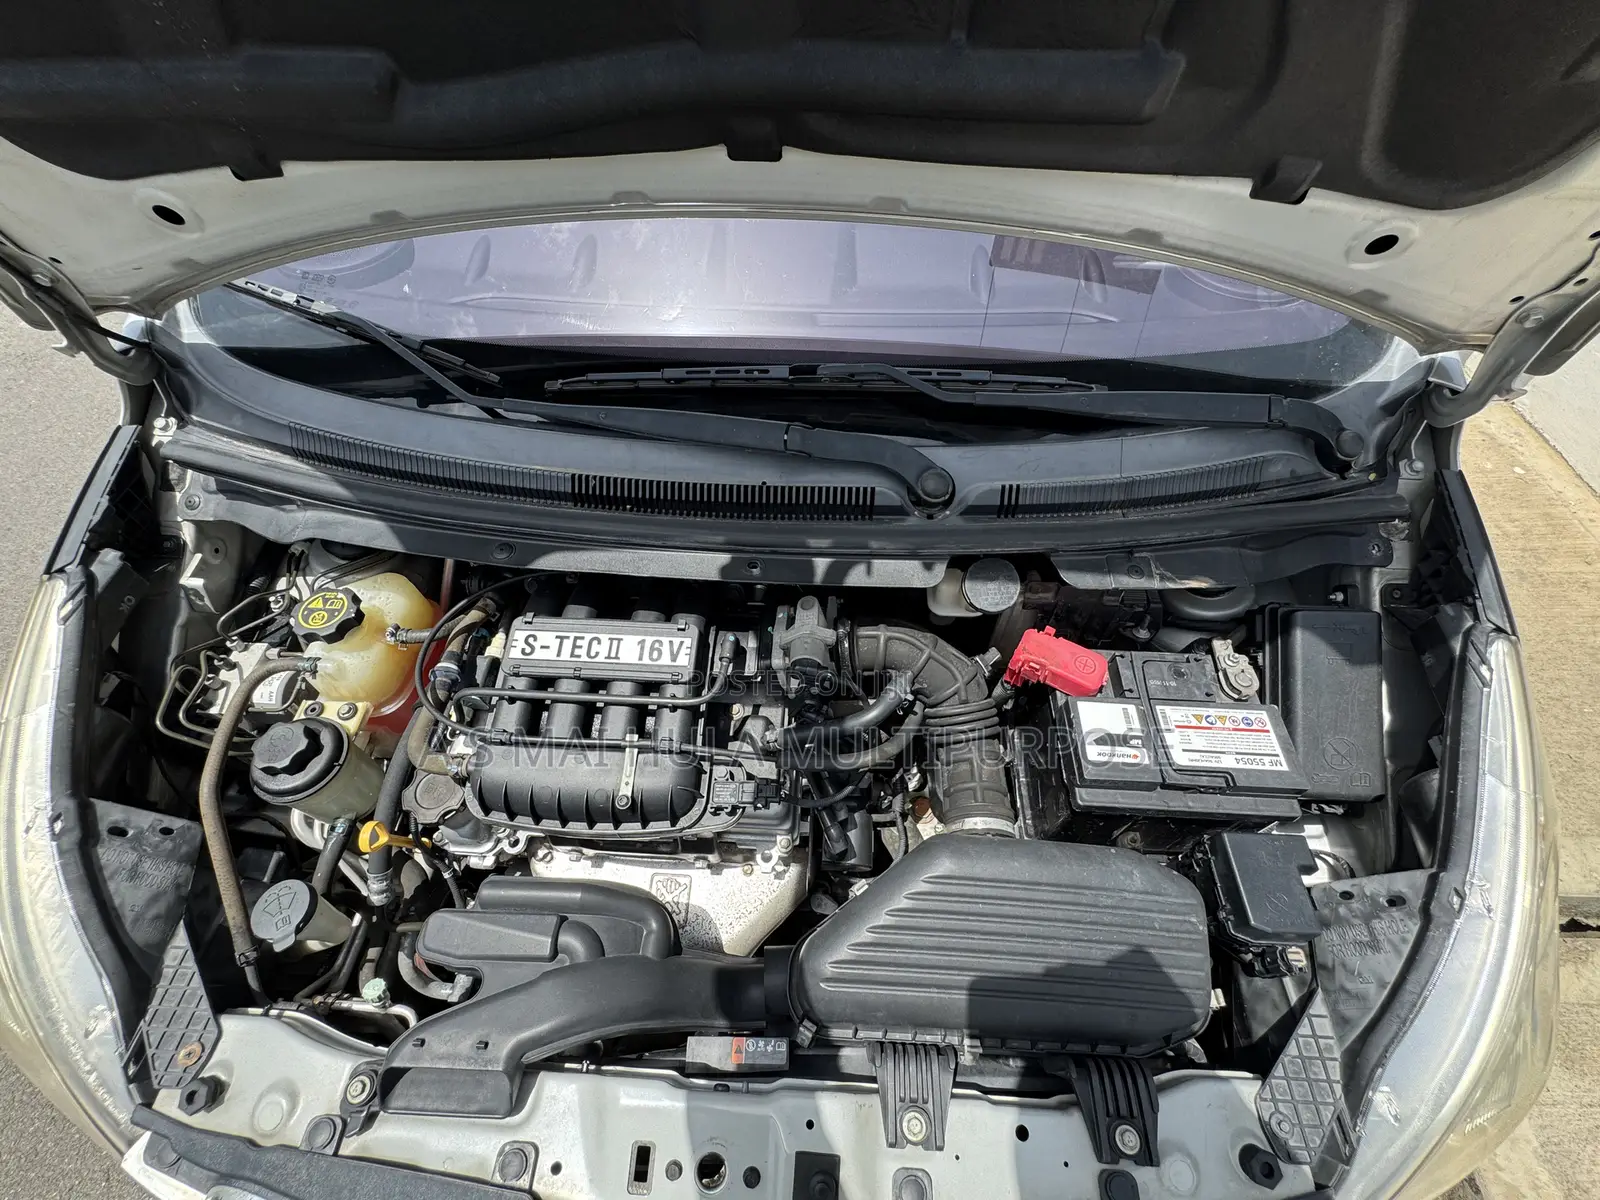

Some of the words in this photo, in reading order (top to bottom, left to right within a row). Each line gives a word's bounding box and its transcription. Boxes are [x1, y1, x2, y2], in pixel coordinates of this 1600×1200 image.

[636, 638, 685, 663] 16V
[1234, 757, 1266, 767] 55054
[1268, 759, 1283, 767] MF
